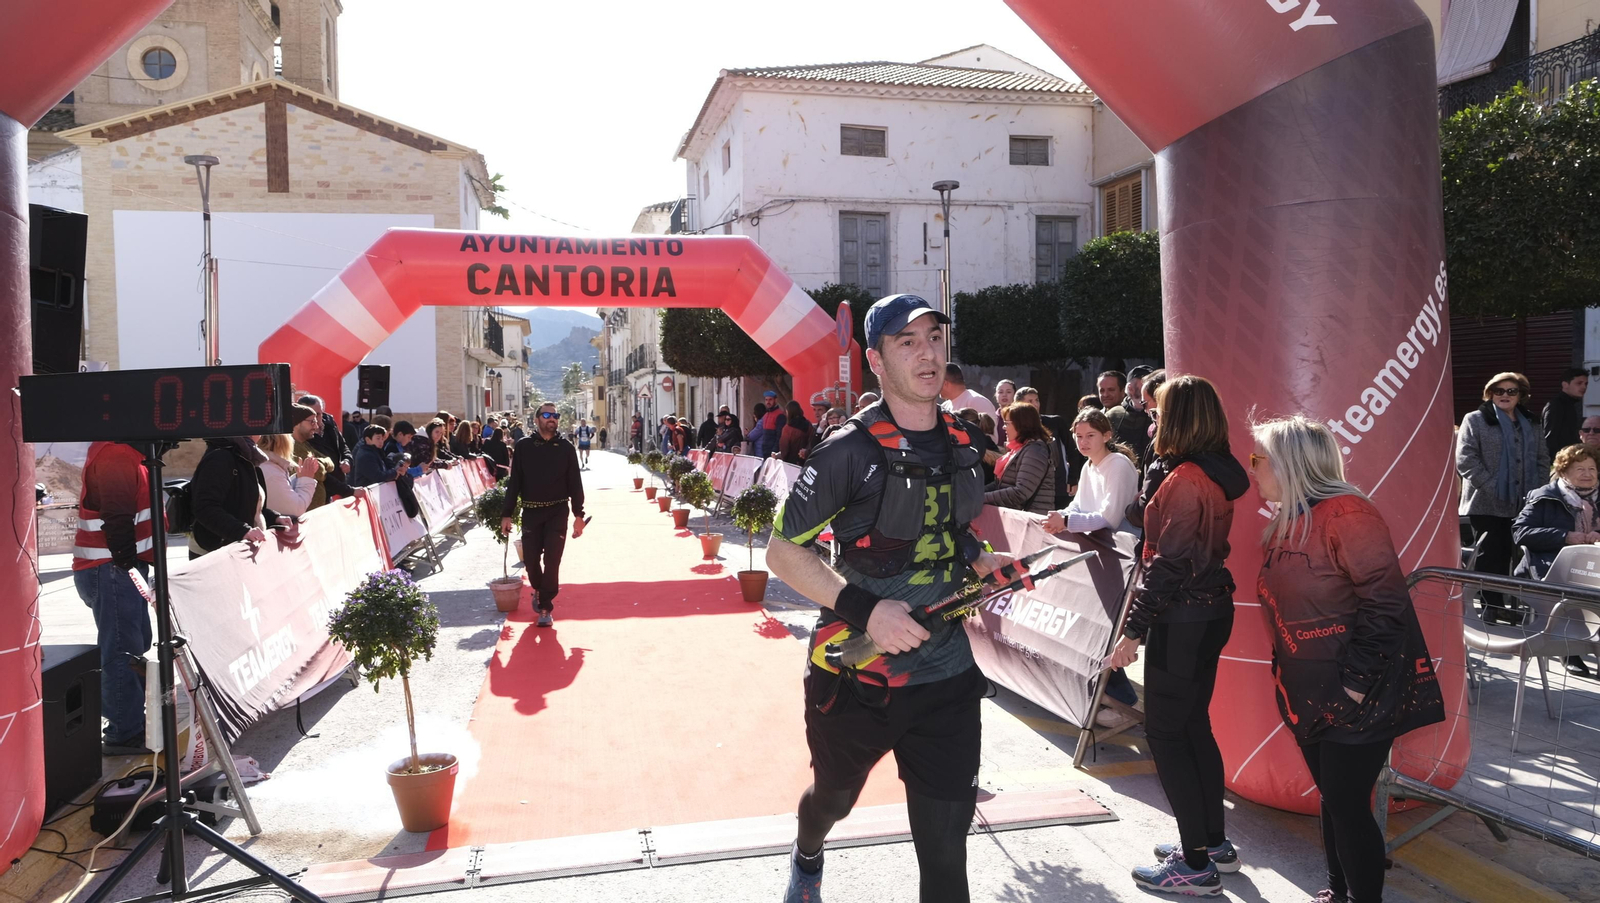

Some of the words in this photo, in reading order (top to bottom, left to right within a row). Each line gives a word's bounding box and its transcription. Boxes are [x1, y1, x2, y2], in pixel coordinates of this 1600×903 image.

[460, 234, 684, 256] AYUNTAMIENTO
[466, 262, 678, 298] CANTORIA
[1296, 623, 1346, 640] Cantoria
[228, 622, 298, 697] TEAMERGY
